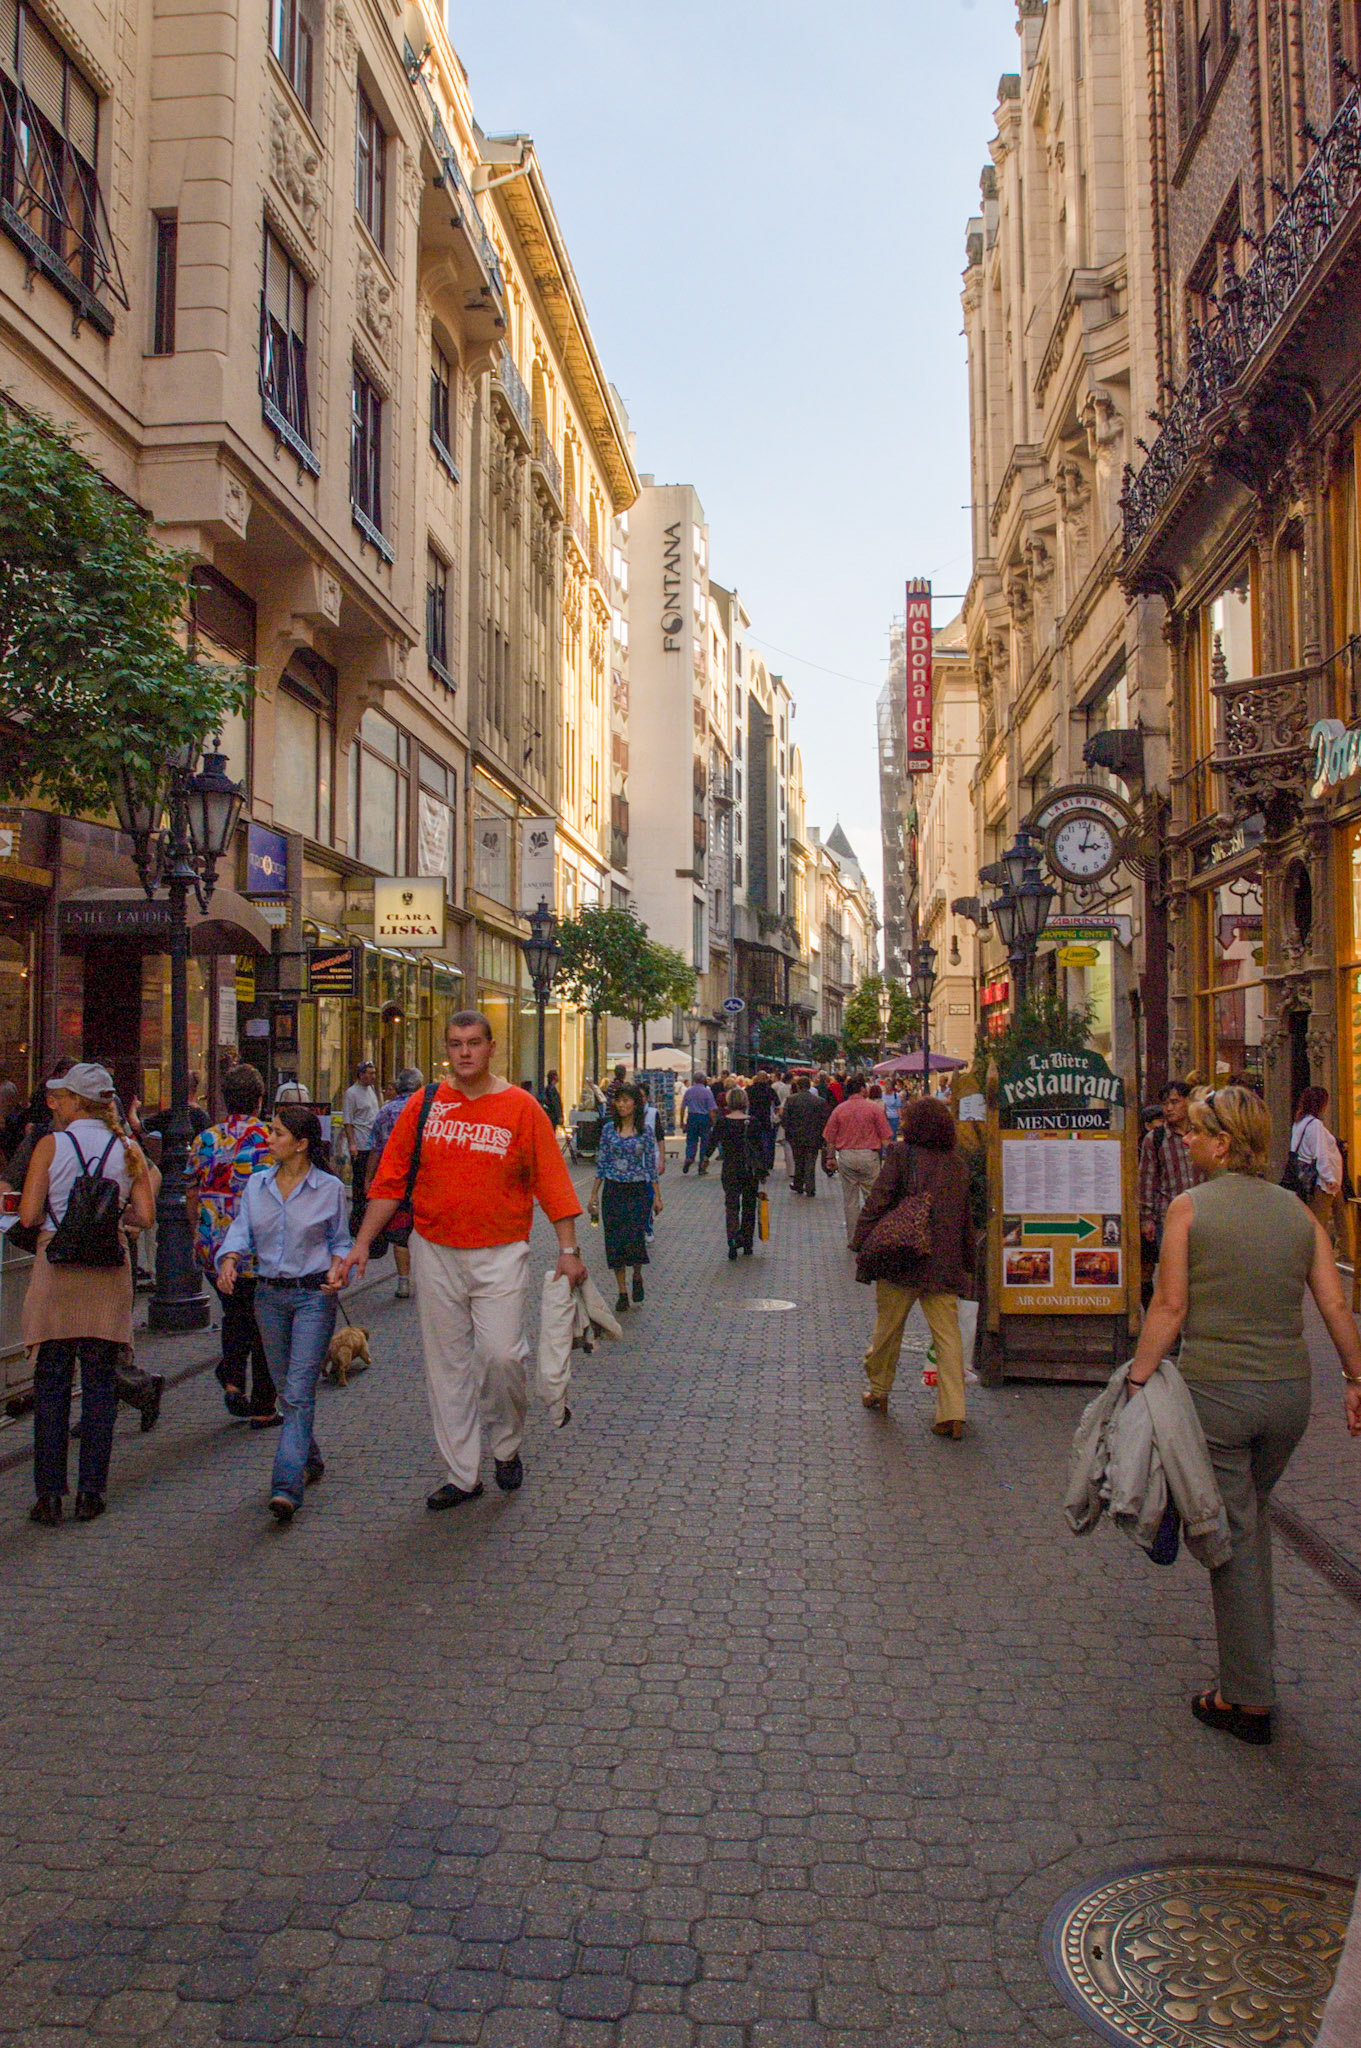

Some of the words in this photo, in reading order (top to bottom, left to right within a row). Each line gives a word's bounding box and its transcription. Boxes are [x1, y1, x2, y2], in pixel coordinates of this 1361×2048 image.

[661, 521, 683, 652] FONTANA
[909, 603, 930, 749] McDonald's
[1047, 797, 1118, 818] LABIRINTUS
[379, 926, 438, 935] LISKA
[1027, 1054, 1050, 1070] La
[1049, 1052, 1089, 1069] Bière
[1003, 1072, 1120, 1104] restaurant
[1016, 1113, 1069, 1130] MENÜ
[442, 1119, 512, 1148] LIMITS
[1016, 1296, 1034, 1306] AIR
[1036, 1296, 1111, 1306] CONDITIONED
